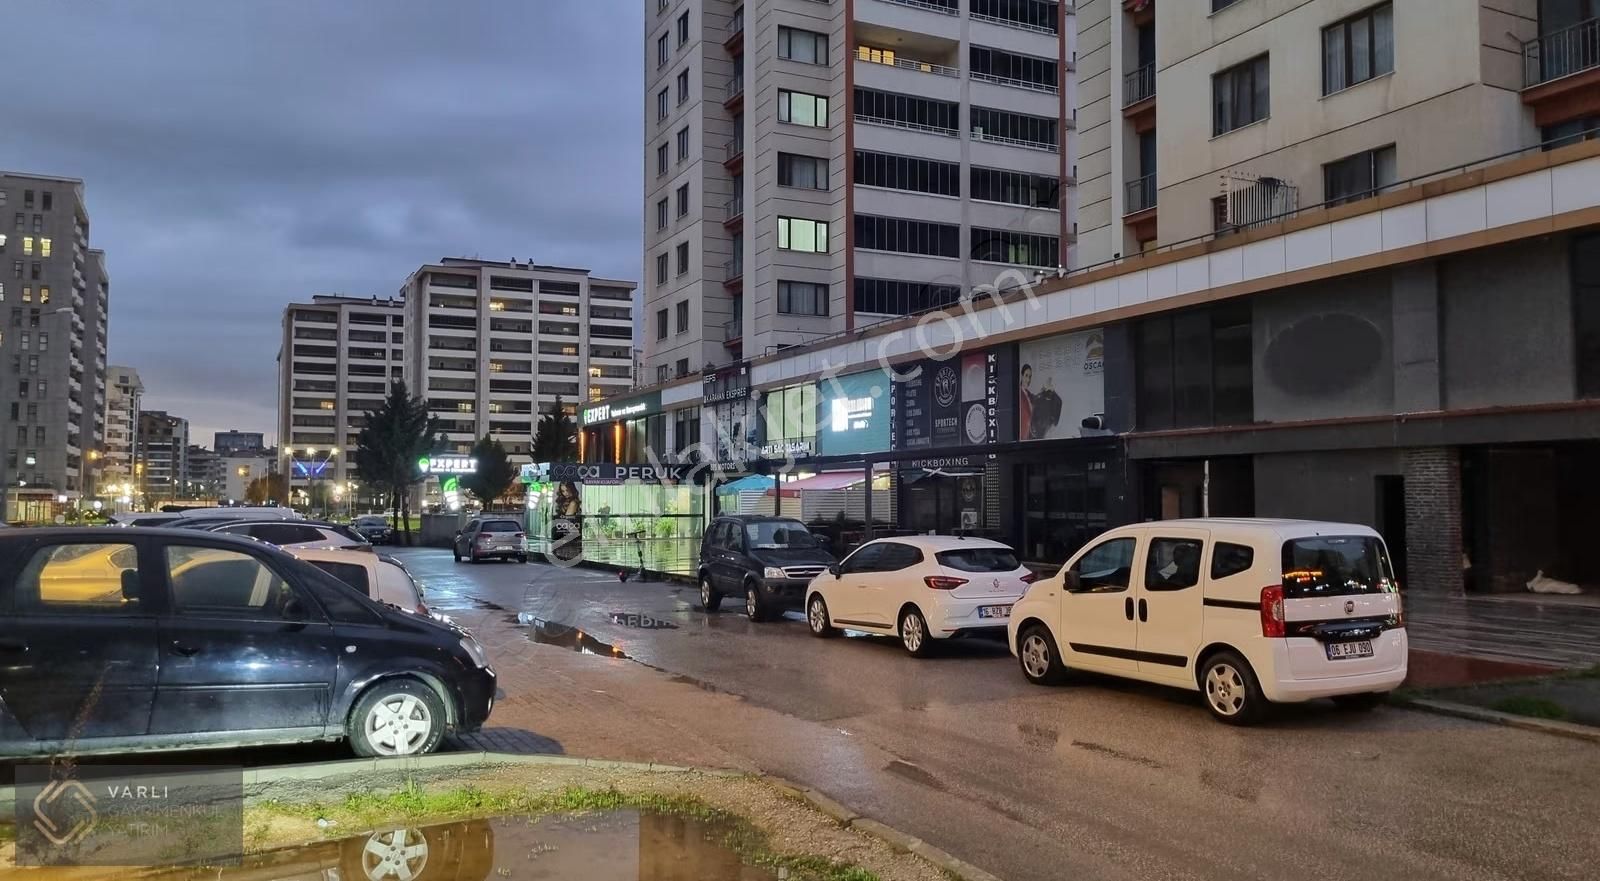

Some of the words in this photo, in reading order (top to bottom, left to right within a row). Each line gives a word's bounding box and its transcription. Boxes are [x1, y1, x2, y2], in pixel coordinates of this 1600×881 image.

[988, 354, 997, 459] KICKBOXIG
[587, 405, 610, 423] EXPERT
[430, 458, 478, 468] EXPERT
[912, 457, 969, 468] KICKBOXING
[615, 467, 682, 479] PERUK
[1331, 644, 1340, 655] 06
